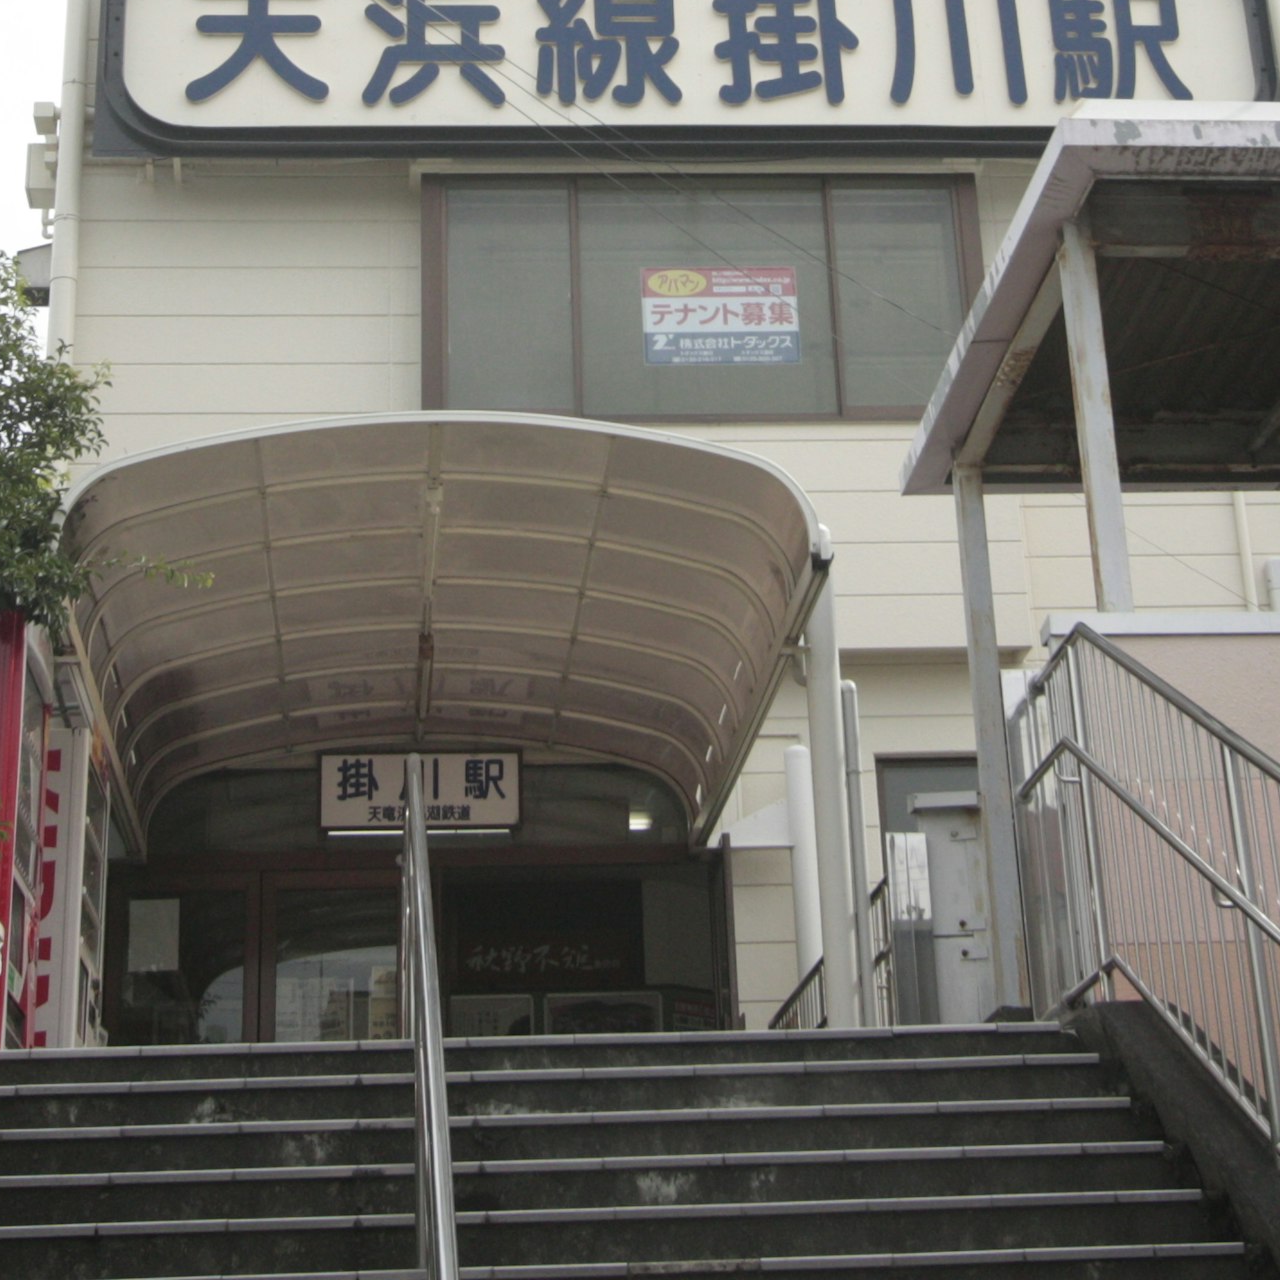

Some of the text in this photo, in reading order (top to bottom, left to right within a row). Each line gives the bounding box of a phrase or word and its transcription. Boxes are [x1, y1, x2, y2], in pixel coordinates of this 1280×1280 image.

[650, 302, 794, 326] テナント募集
[679, 335, 793, 350] 株式会社トダックス
